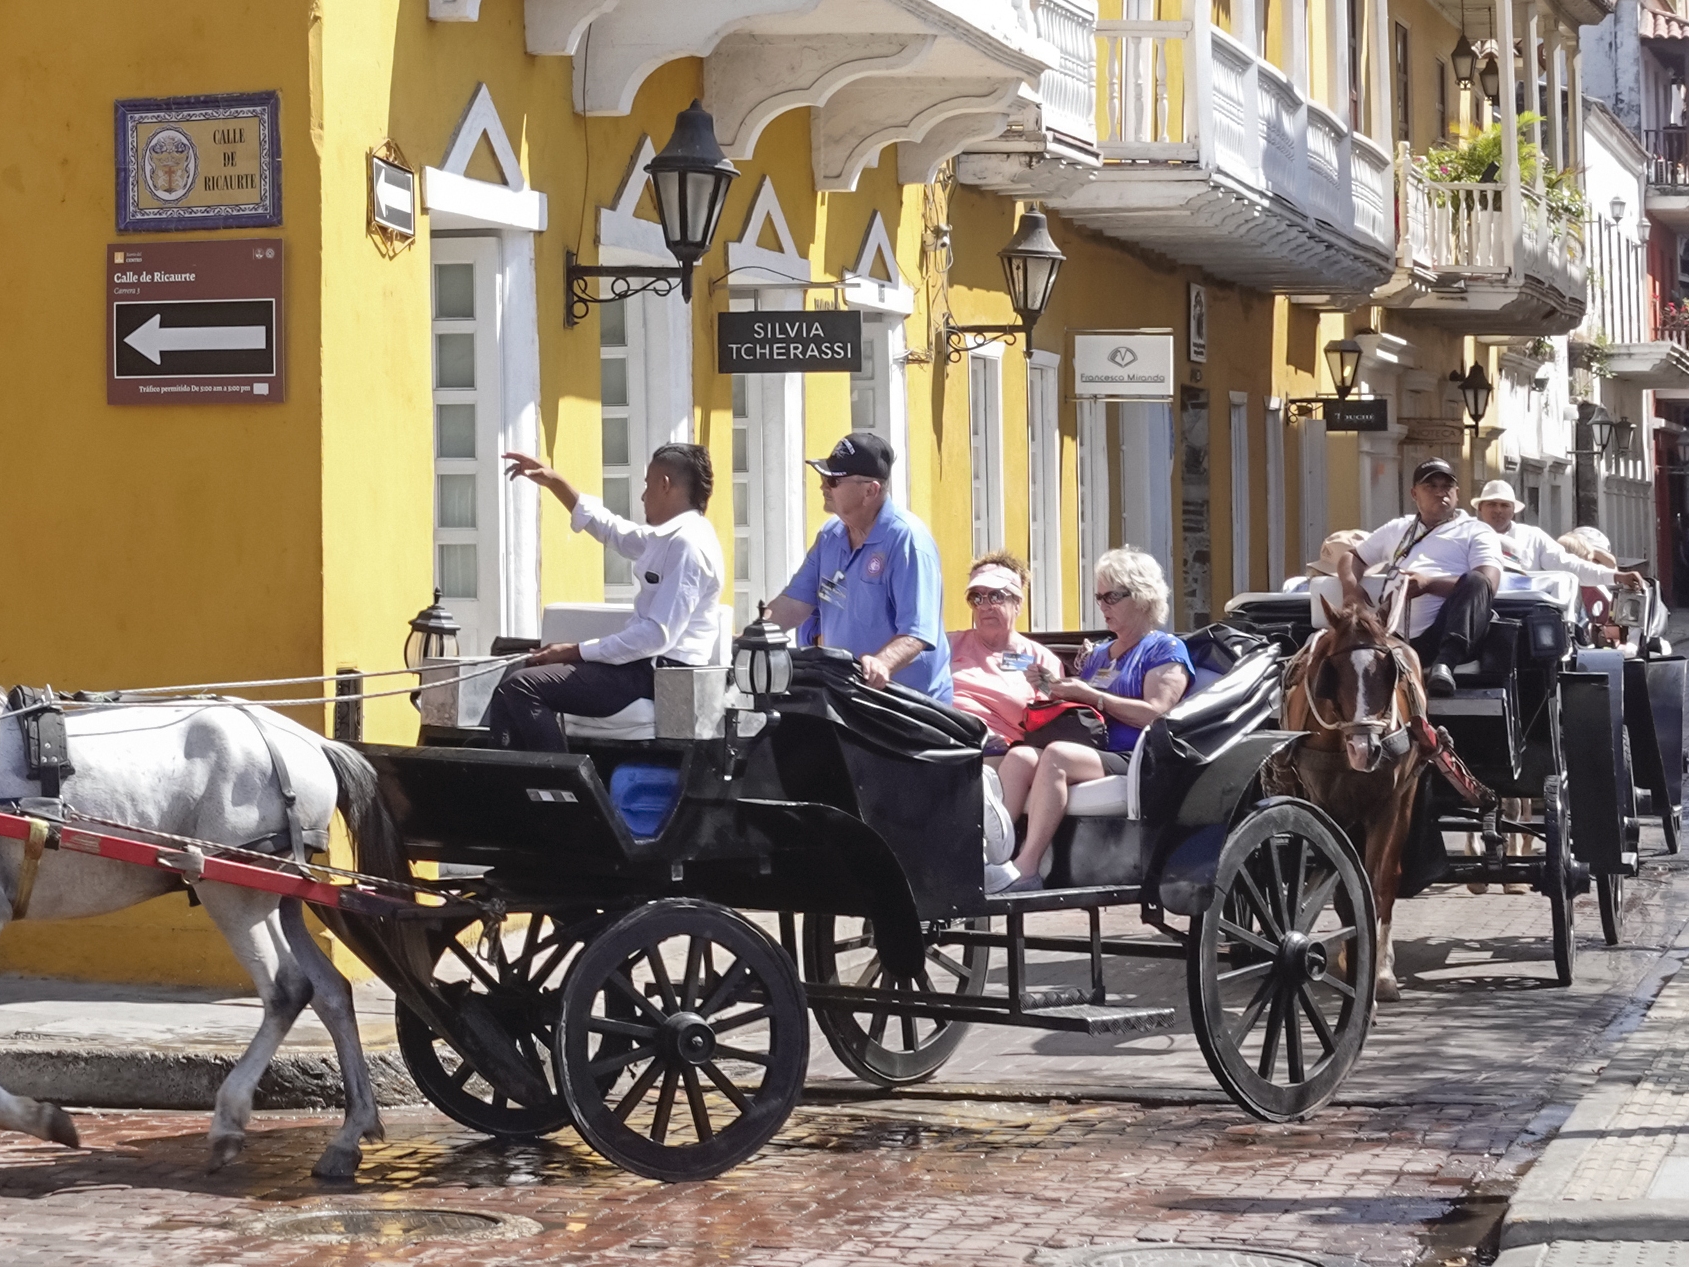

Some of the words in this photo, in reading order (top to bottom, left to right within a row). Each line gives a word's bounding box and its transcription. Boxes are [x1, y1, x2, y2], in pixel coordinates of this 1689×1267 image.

[213, 128, 245, 145] CALLE
[223, 151, 237, 167] DE
[204, 174, 257, 191] RICAURTE
[114, 271, 138, 283] Calle
[140, 271, 152, 282] de
[153, 271, 196, 282] Ricaurte
[753, 322, 824, 339] SILVIA
[728, 342, 852, 360] TCHERASSI
[1080, 373, 1125, 382] Francesca
[1127, 373, 1165, 382] Miranda
[139, 385, 160, 393] Tráfico
[161, 384, 191, 394] permitido
[191, 384, 200, 392] De
